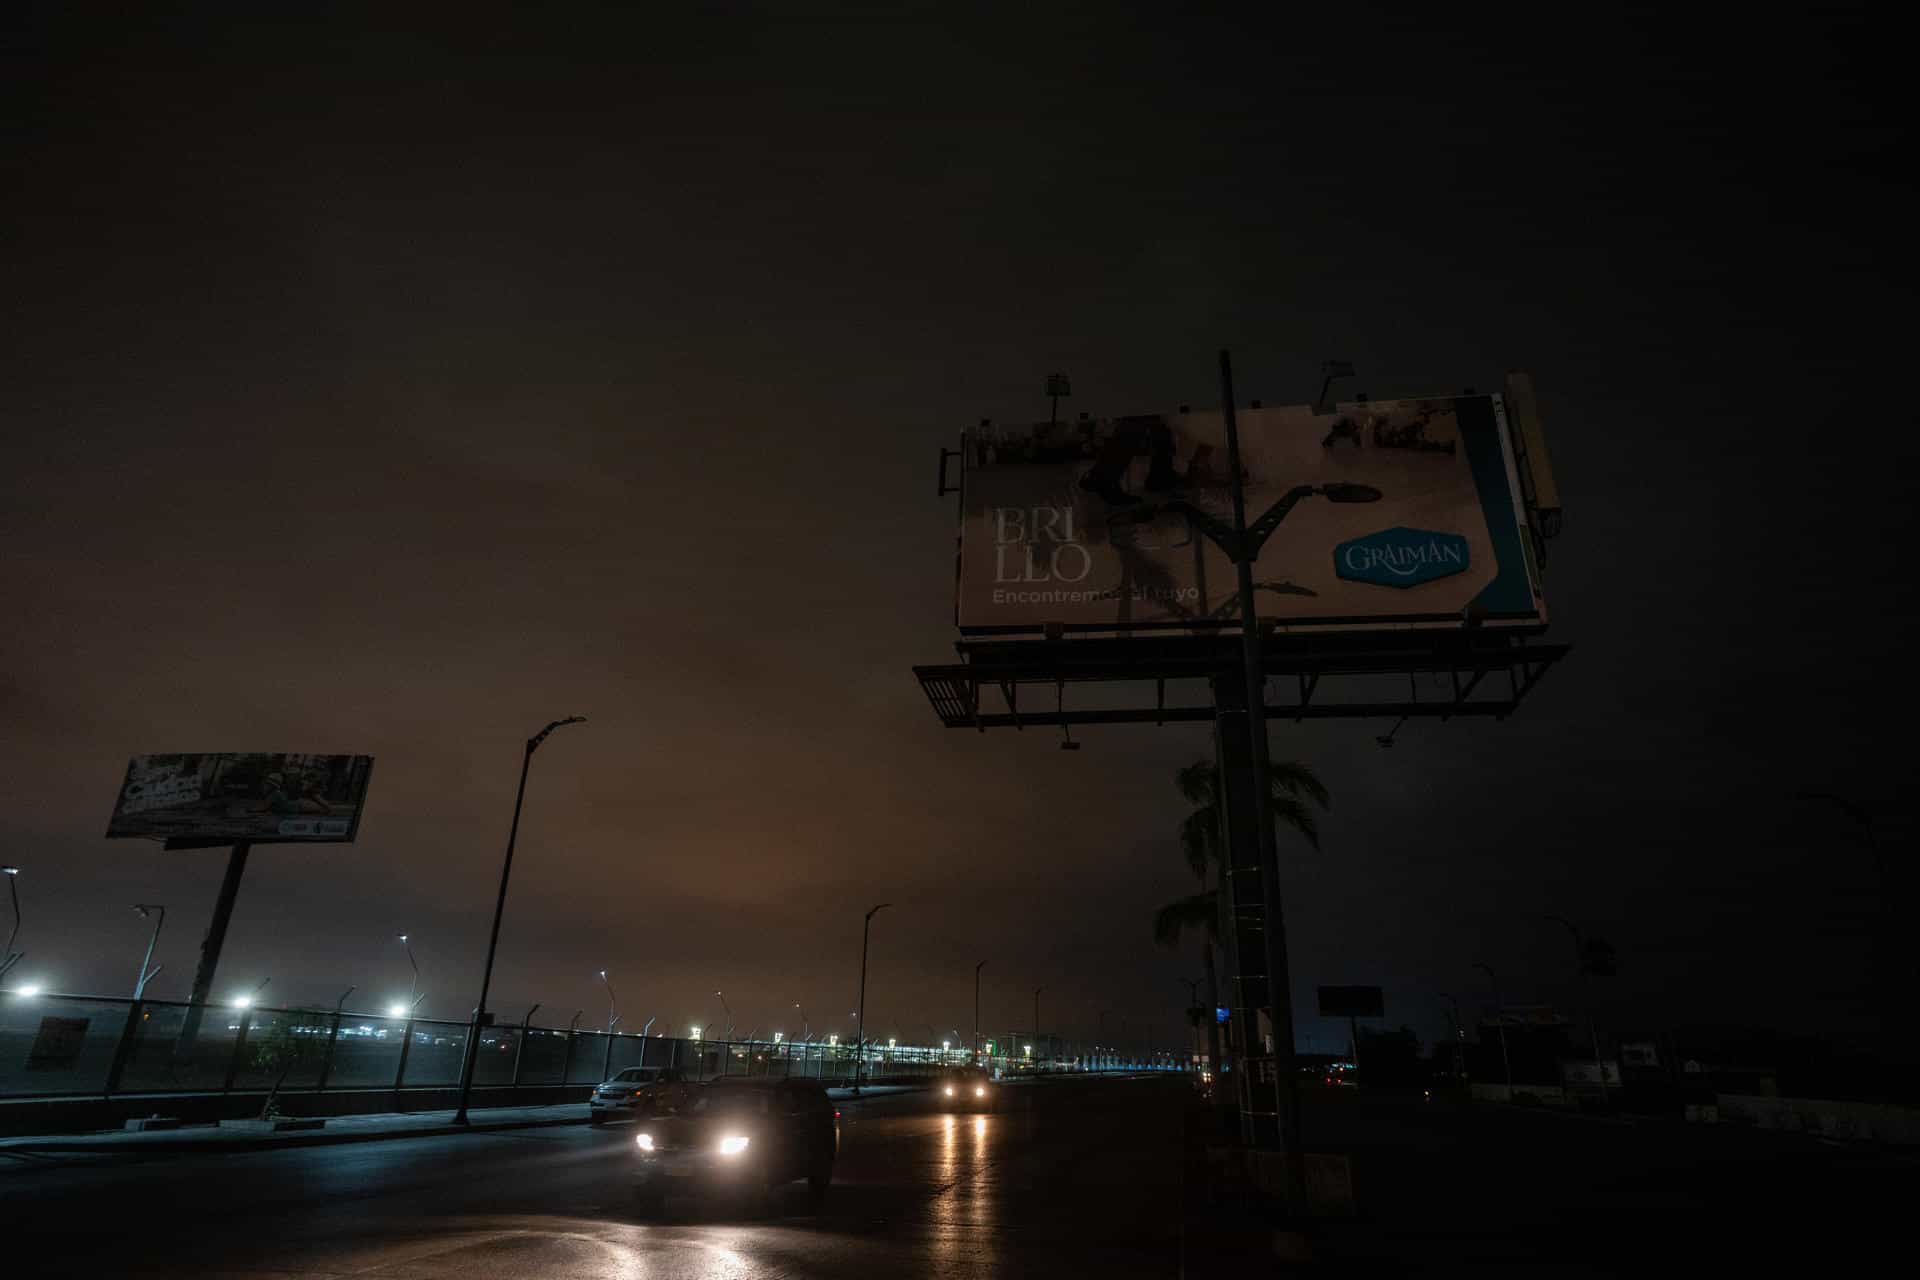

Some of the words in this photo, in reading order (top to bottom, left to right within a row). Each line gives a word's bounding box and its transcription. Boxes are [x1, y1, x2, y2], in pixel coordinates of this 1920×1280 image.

[993, 506, 1080, 543] BRI
[993, 543, 1092, 582] LLO
[1345, 538, 1461, 575] GRAIMAN
